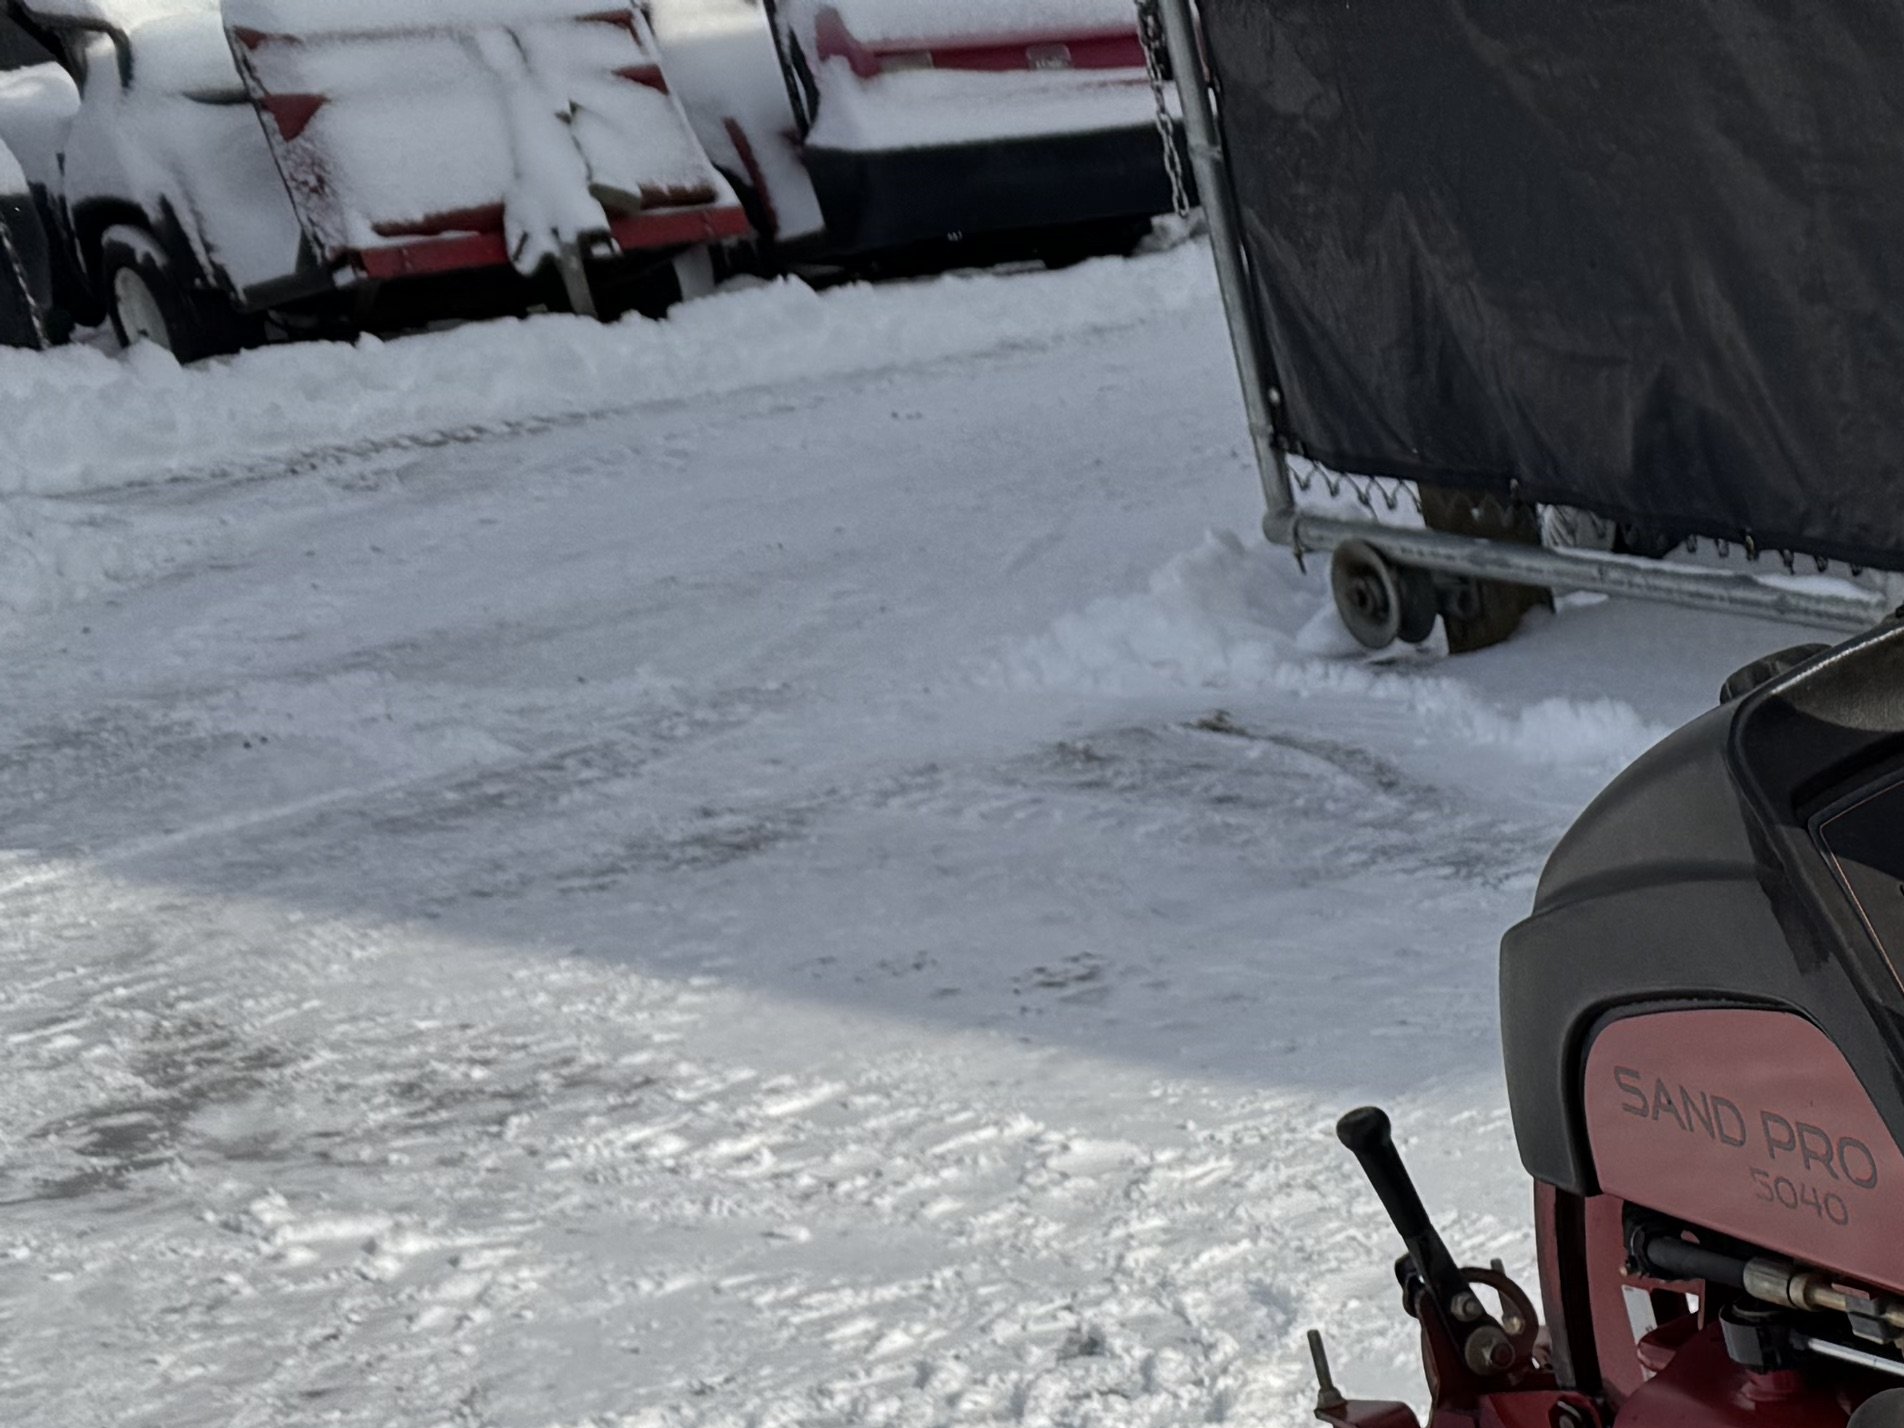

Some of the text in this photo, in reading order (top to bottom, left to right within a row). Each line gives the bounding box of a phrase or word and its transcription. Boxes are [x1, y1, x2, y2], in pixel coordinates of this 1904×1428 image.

[1613, 1065, 1878, 1190] SAND PRO
[1750, 1167, 1849, 1227] 5040
